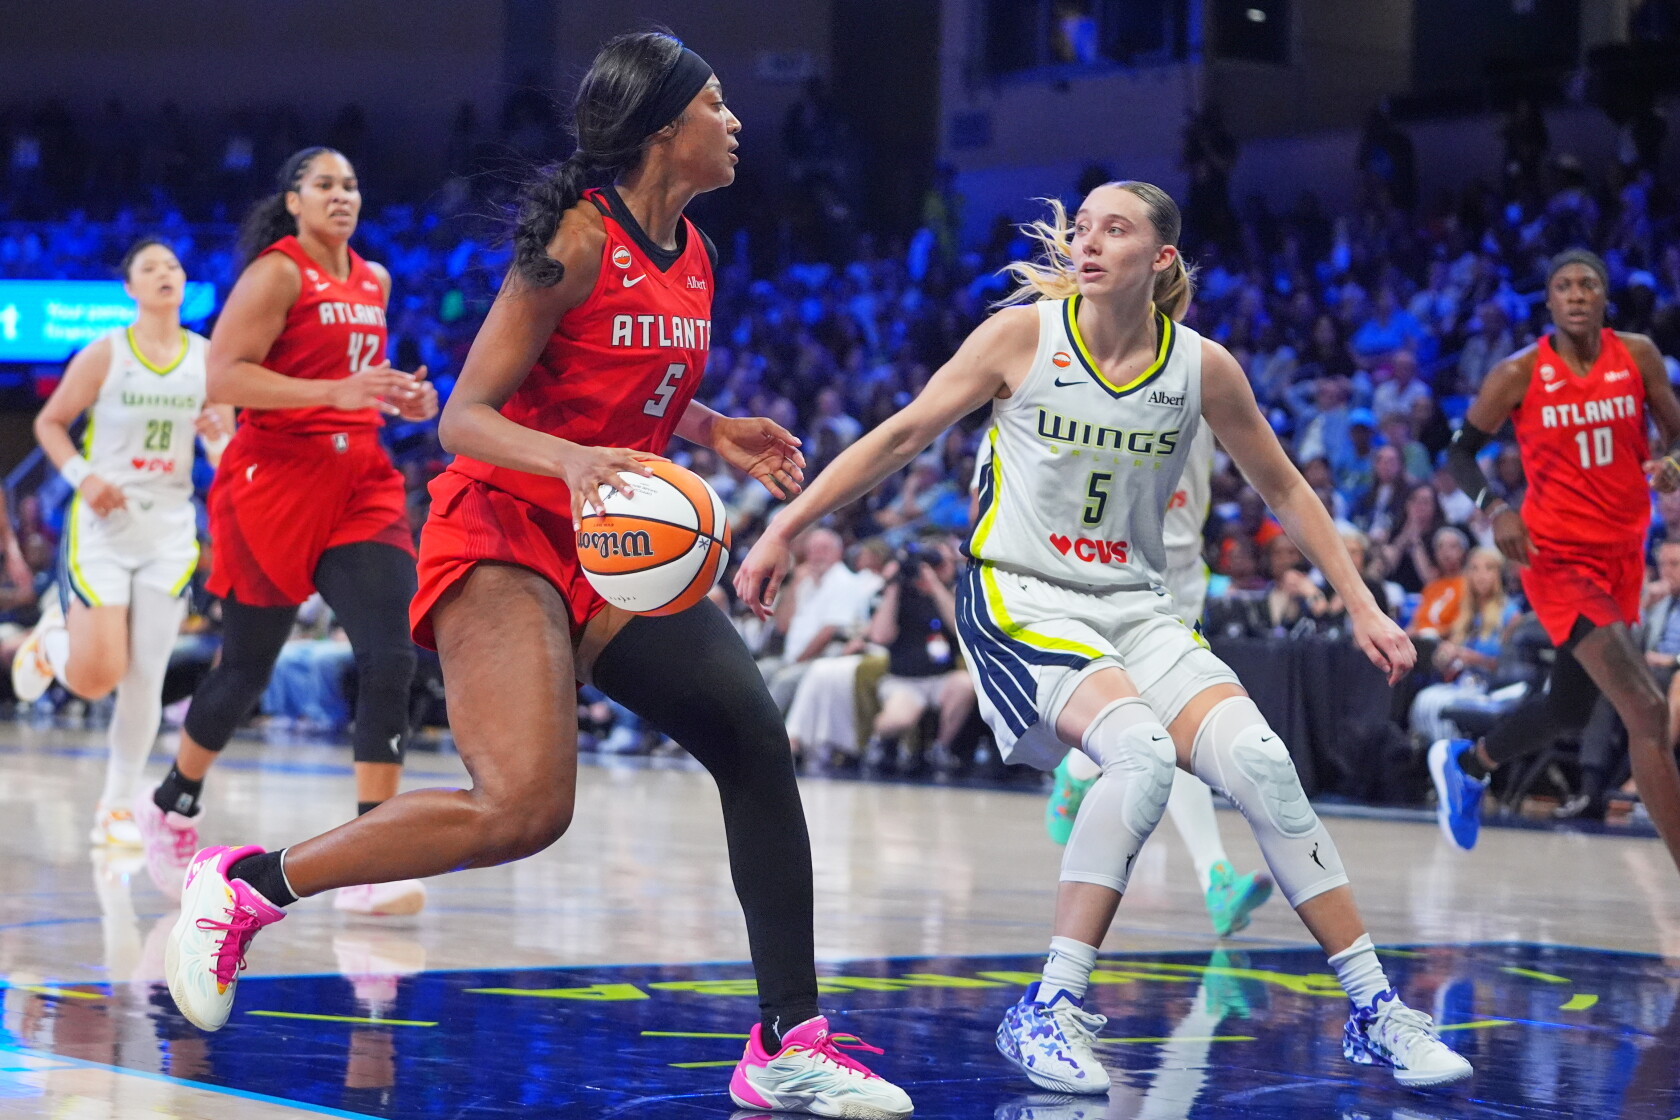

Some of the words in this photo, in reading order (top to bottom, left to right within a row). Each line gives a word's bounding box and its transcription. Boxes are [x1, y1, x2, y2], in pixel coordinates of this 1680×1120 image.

[686, 275, 706, 290] Albert
[318, 302, 387, 327] ATLANT
[347, 331, 379, 374] 42
[643, 363, 687, 418] 5
[1148, 391, 1185, 406] Albert
[1541, 395, 1636, 428] ATLANTA
[145, 420, 173, 451] 28
[1575, 427, 1613, 469] 10
[1081, 470, 1114, 529] 5
[577, 530, 655, 559] Wilson
[1074, 537, 1129, 564] CVS
